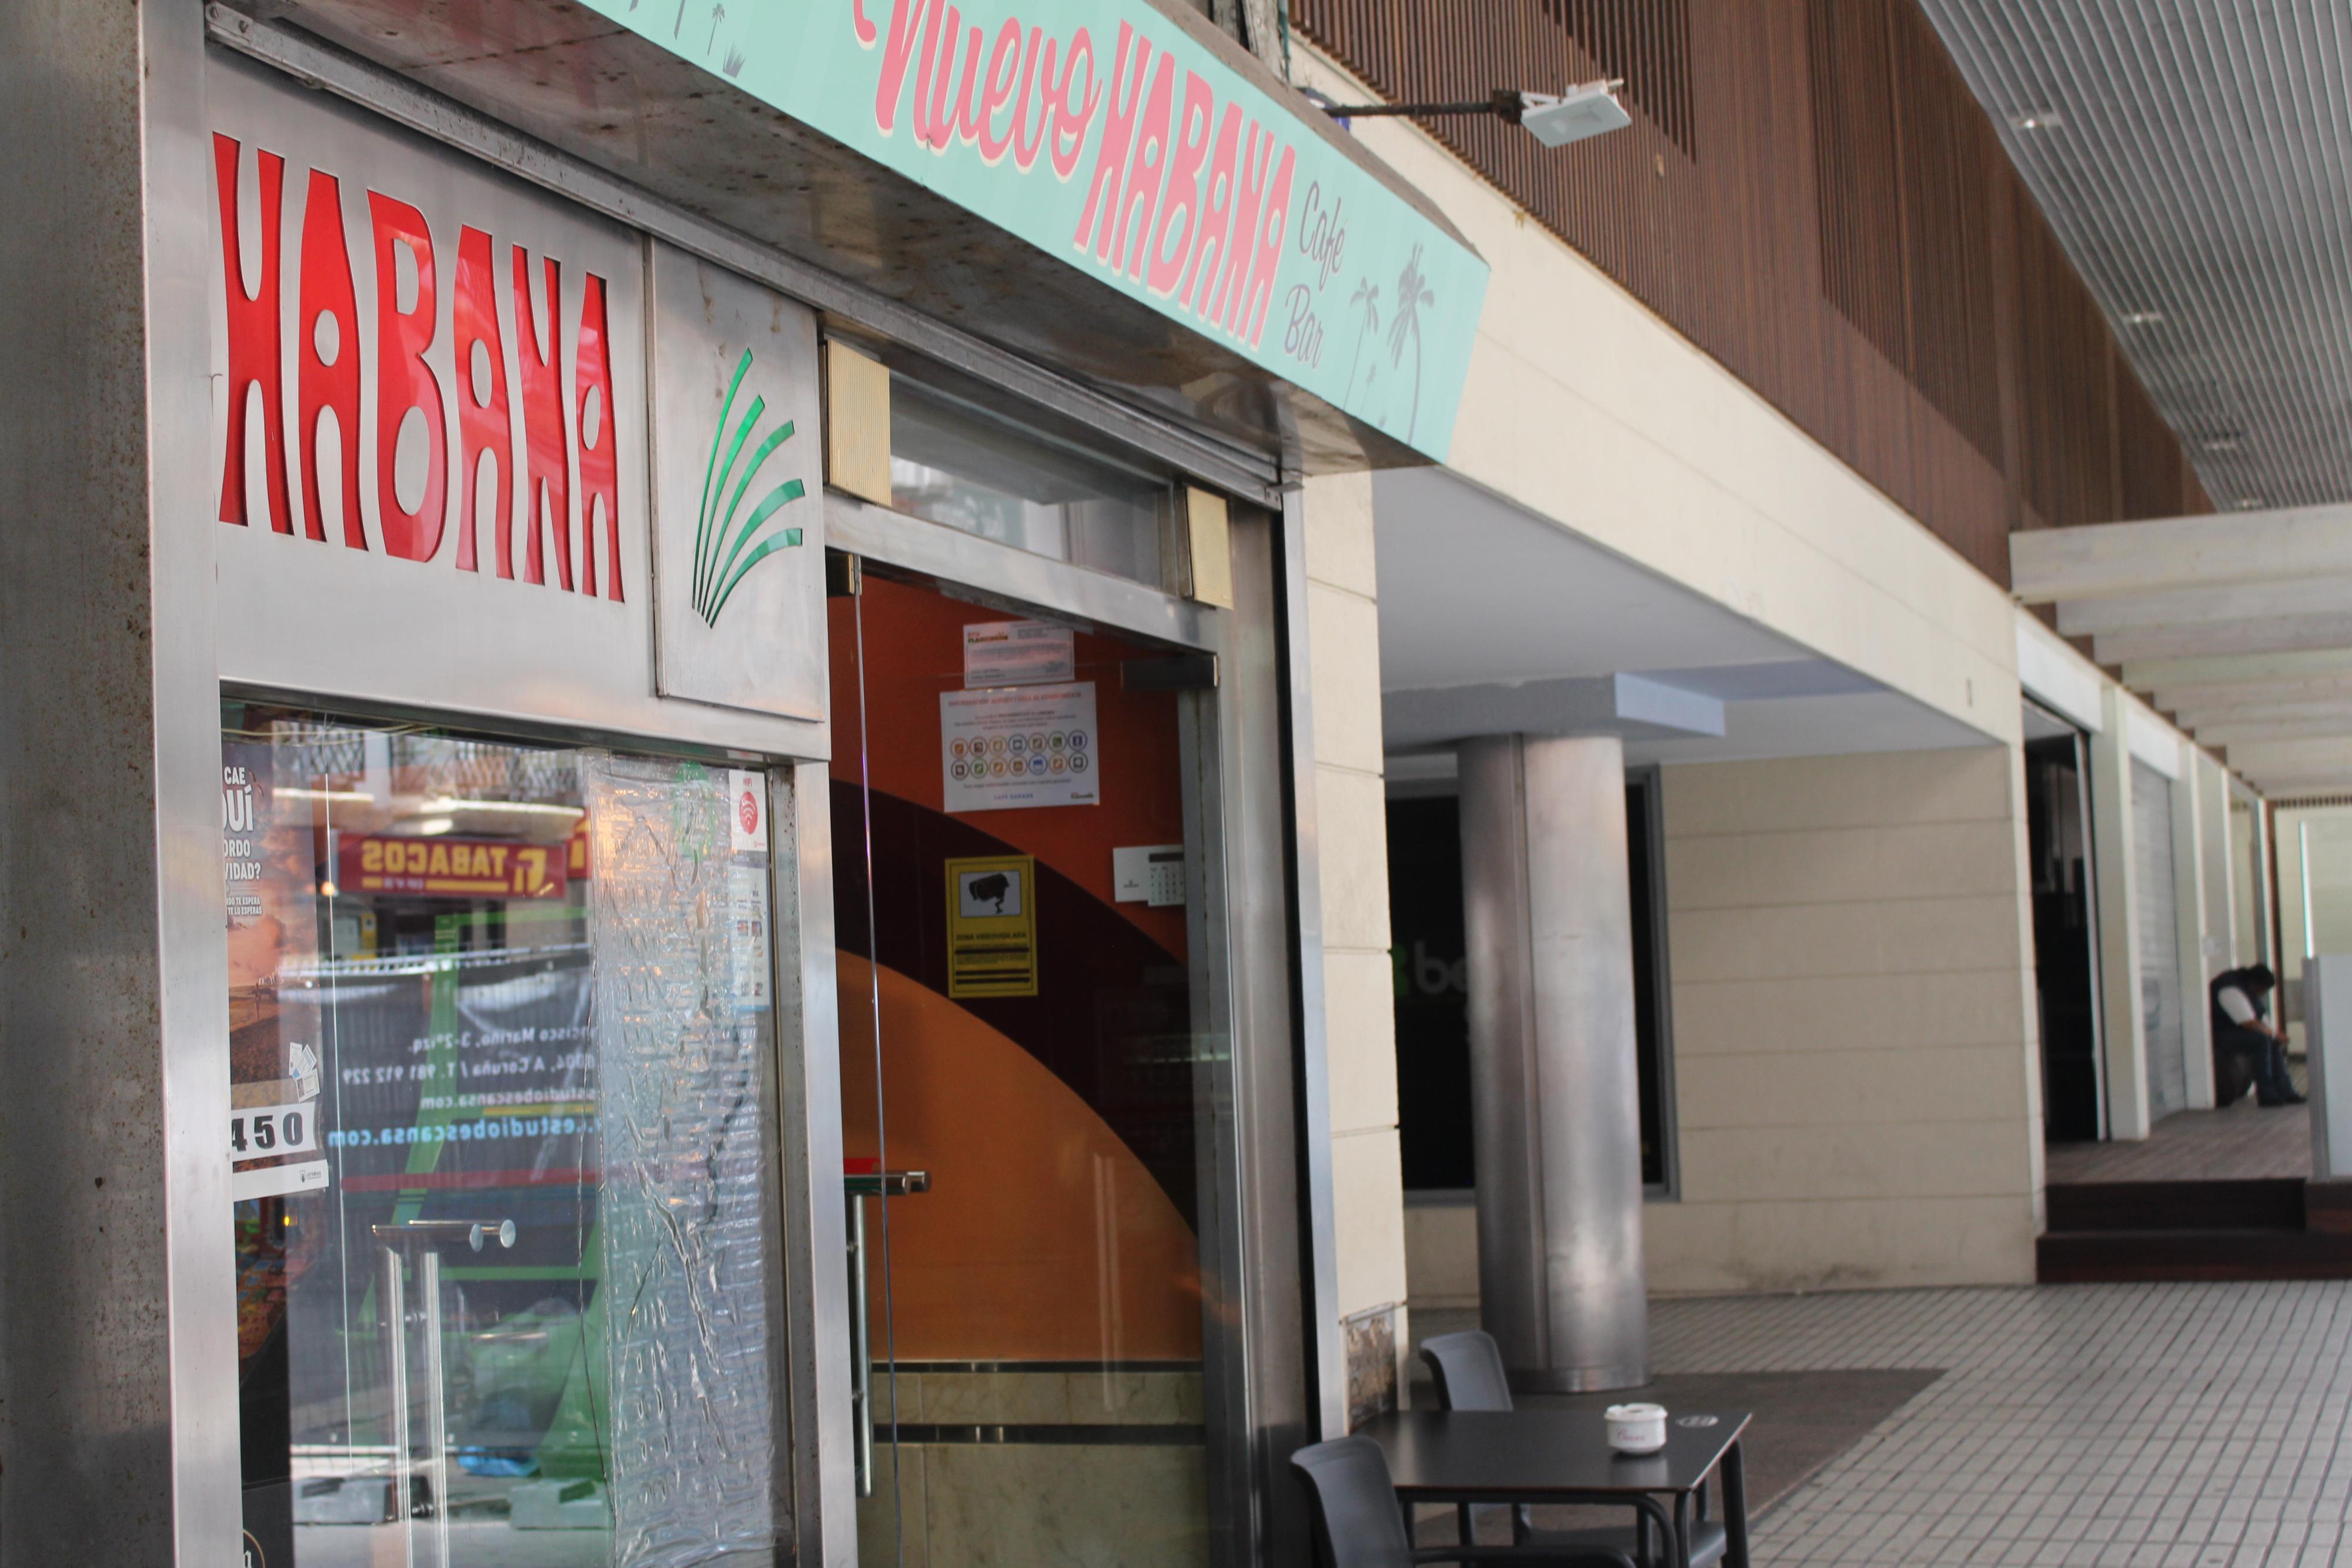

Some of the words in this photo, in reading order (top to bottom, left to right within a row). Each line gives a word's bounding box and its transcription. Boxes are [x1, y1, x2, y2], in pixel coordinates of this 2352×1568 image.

[1073, 19, 1295, 353] HABANA
[1299, 180, 1350, 291] Café
[212, 131, 624, 603] HABANA
[1284, 284, 1324, 370] Bar
[224, 766, 246, 785] CAE
[242, 897, 260, 905] ESPERA
[242, 905, 262, 915] ESPERAS
